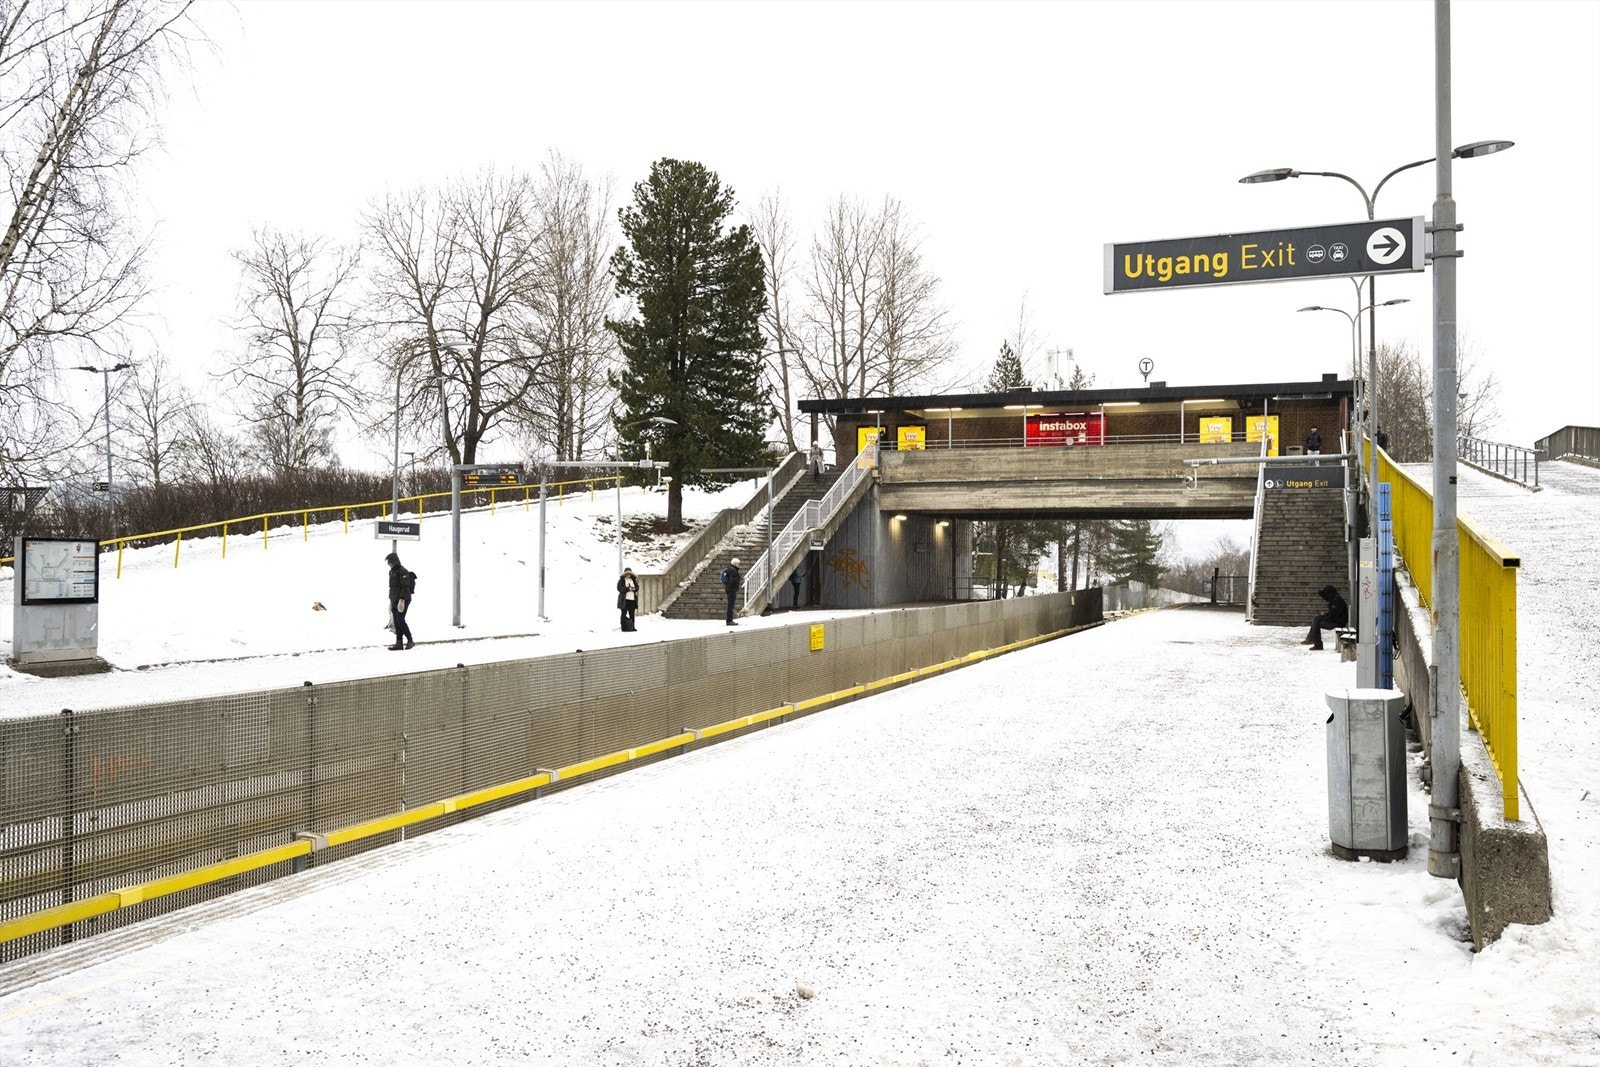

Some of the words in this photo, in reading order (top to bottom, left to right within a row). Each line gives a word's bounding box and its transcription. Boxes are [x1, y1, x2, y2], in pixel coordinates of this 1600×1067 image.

[1124, 251, 1229, 282] Utgang
[1241, 242, 1296, 270] Exit
[1039, 420, 1087, 431] instabox
[1286, 480, 1313, 488] Utgang
[388, 525, 410, 534] Haugerud
